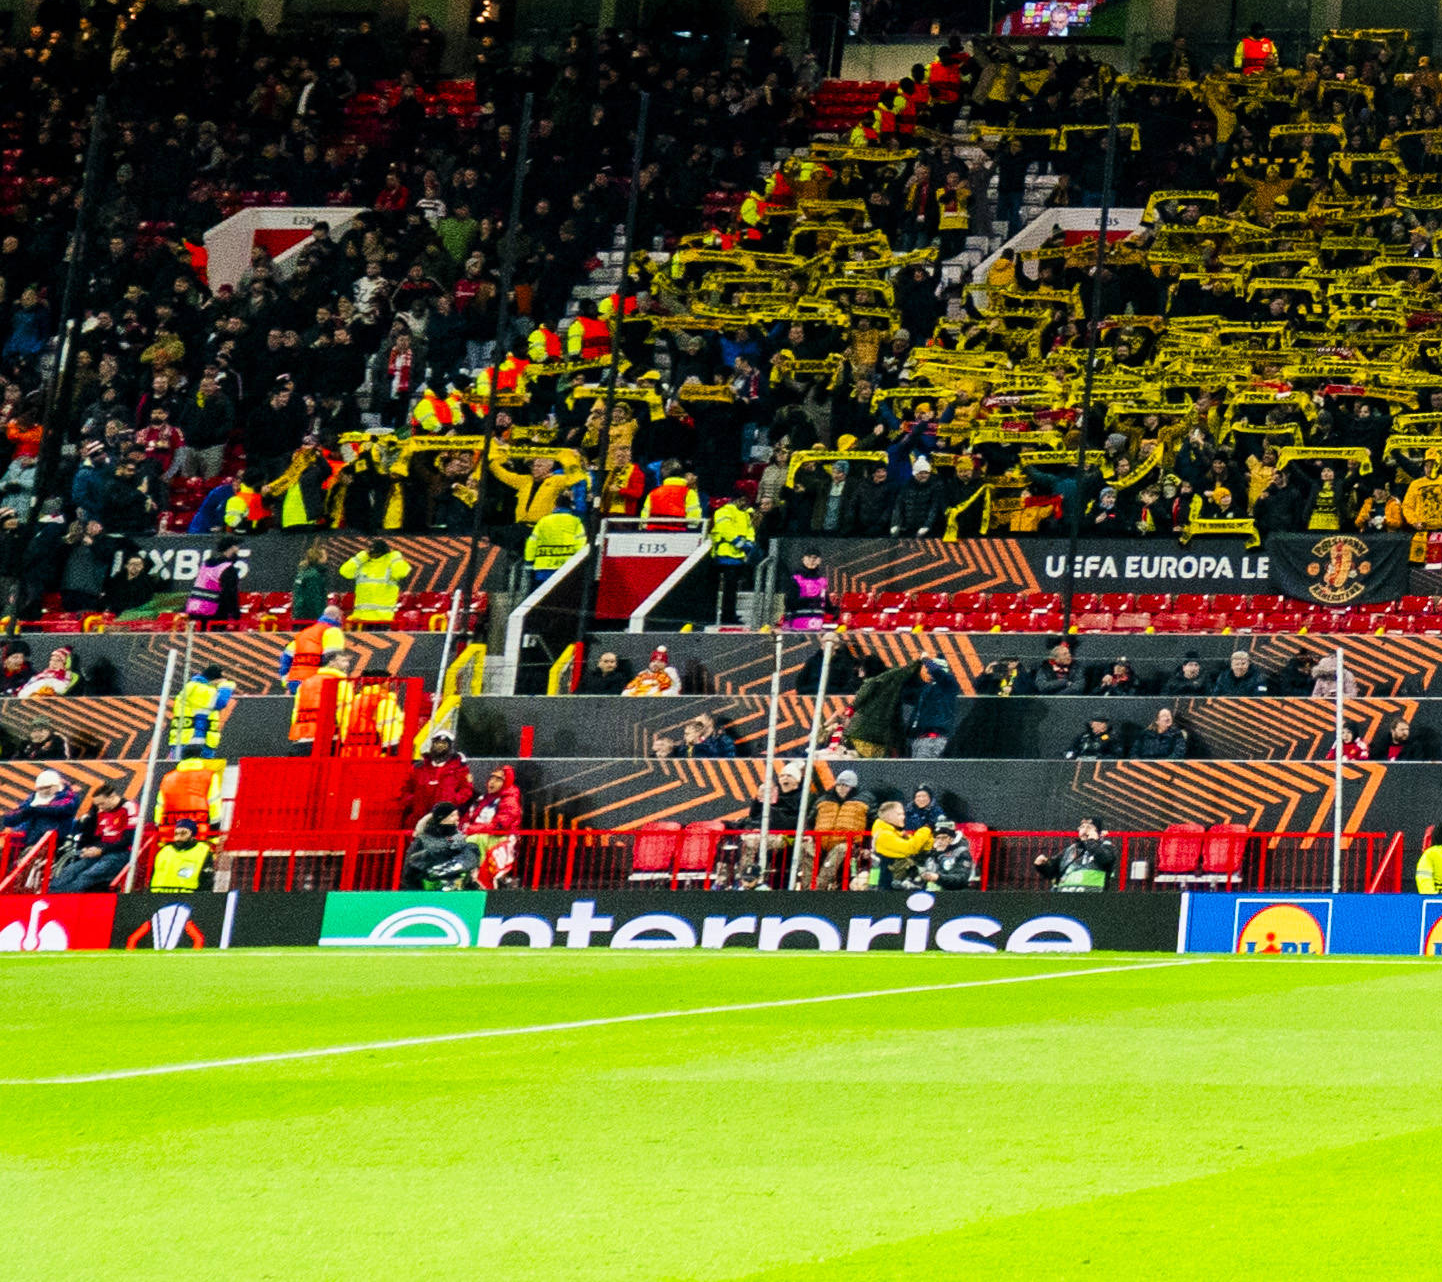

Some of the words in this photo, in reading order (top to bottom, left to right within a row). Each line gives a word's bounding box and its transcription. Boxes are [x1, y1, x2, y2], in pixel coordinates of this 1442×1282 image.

[638, 541, 668, 554] E135
[1045, 555, 1118, 579] UEFA
[1125, 554, 1234, 580] EUROPA
